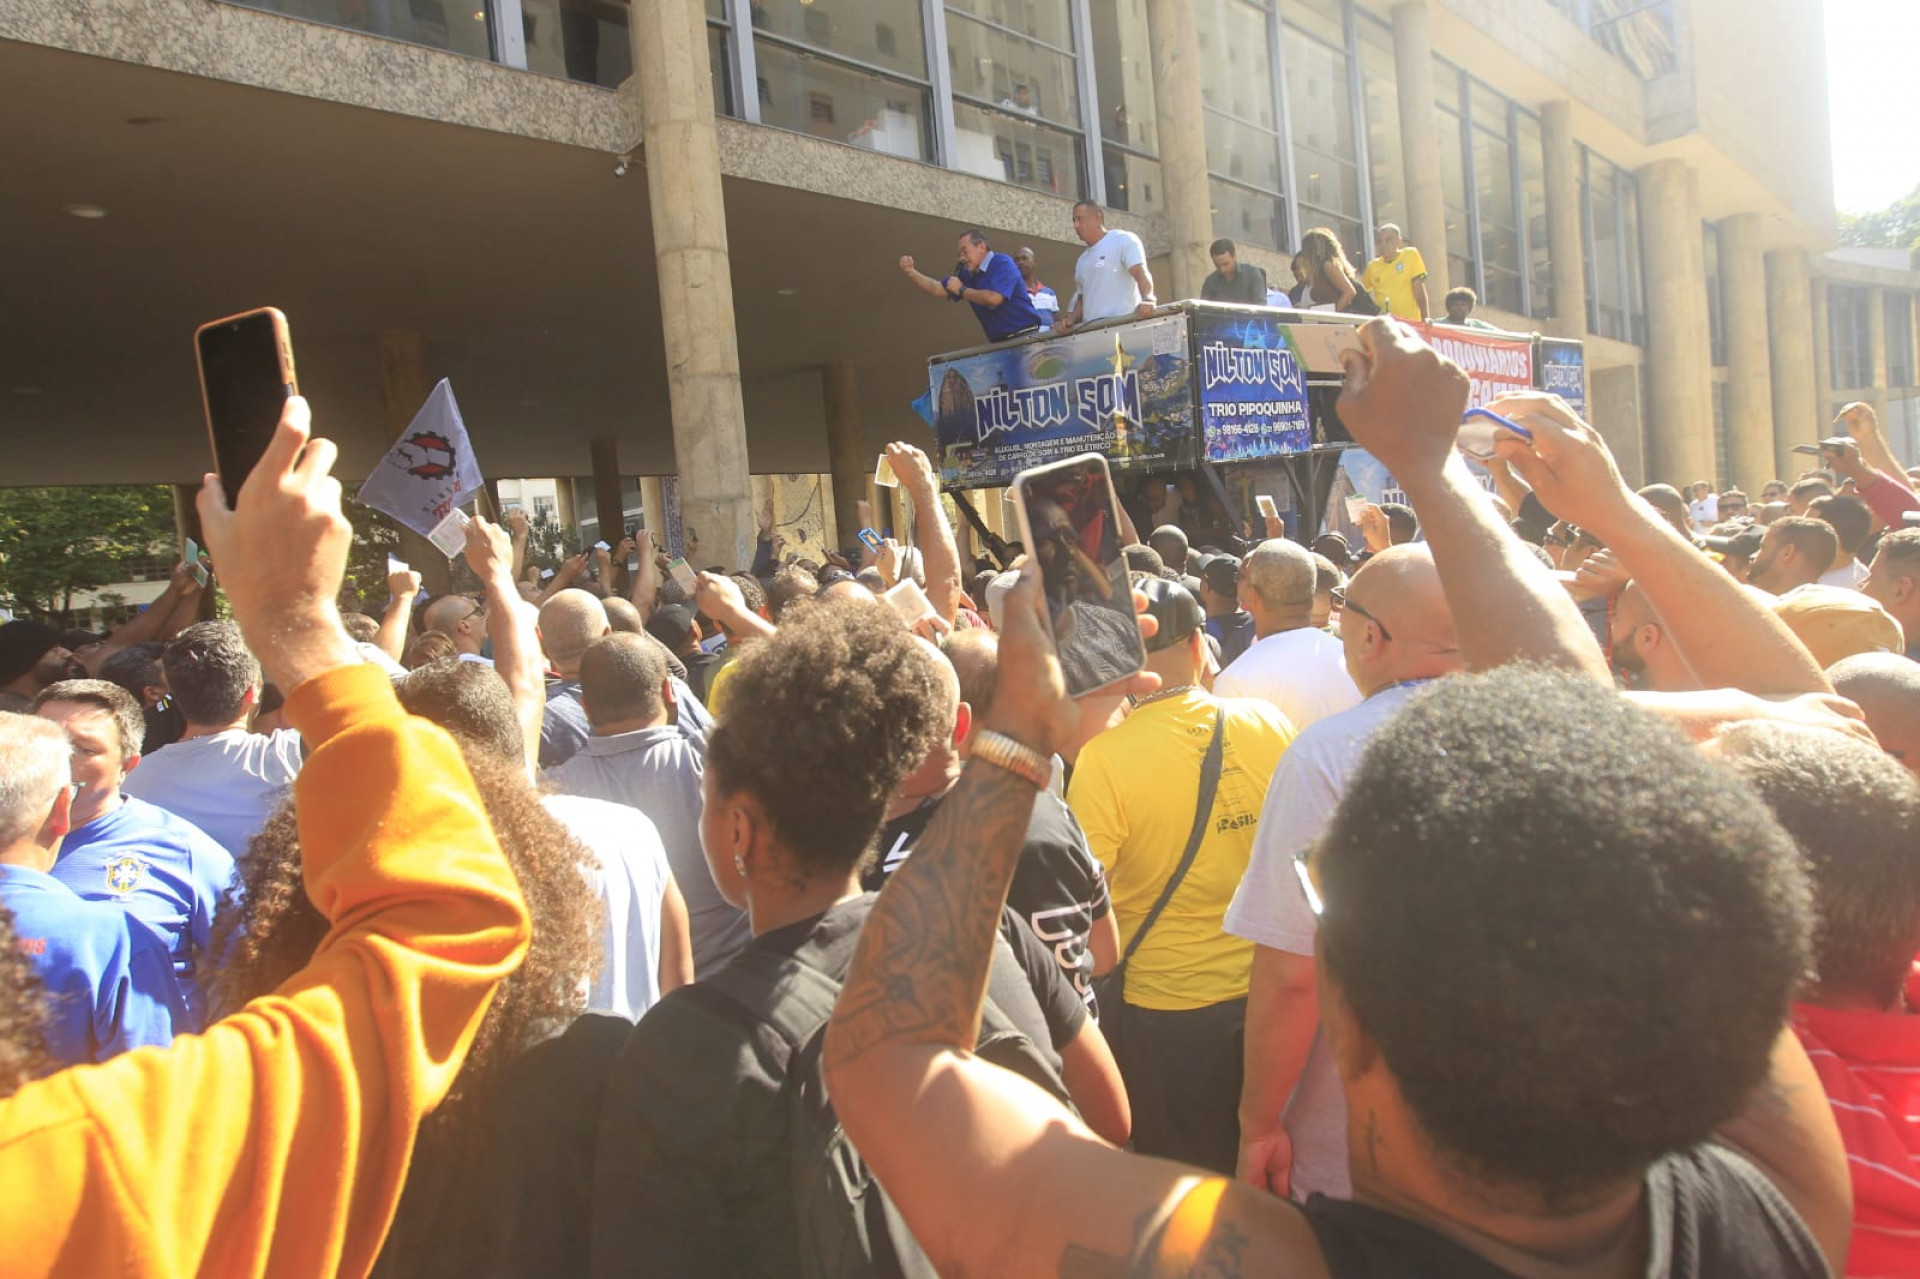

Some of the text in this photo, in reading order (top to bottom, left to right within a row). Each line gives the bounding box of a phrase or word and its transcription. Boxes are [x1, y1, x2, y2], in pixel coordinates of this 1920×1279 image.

[1203, 341, 1303, 394] NILTON SOM
[974, 369, 1144, 442] NILTON SOM
[1208, 401, 1303, 417] TRIO PIPOQUINHA
[1037, 447, 1054, 457] SOM
[1060, 445, 1076, 454] TRIO
